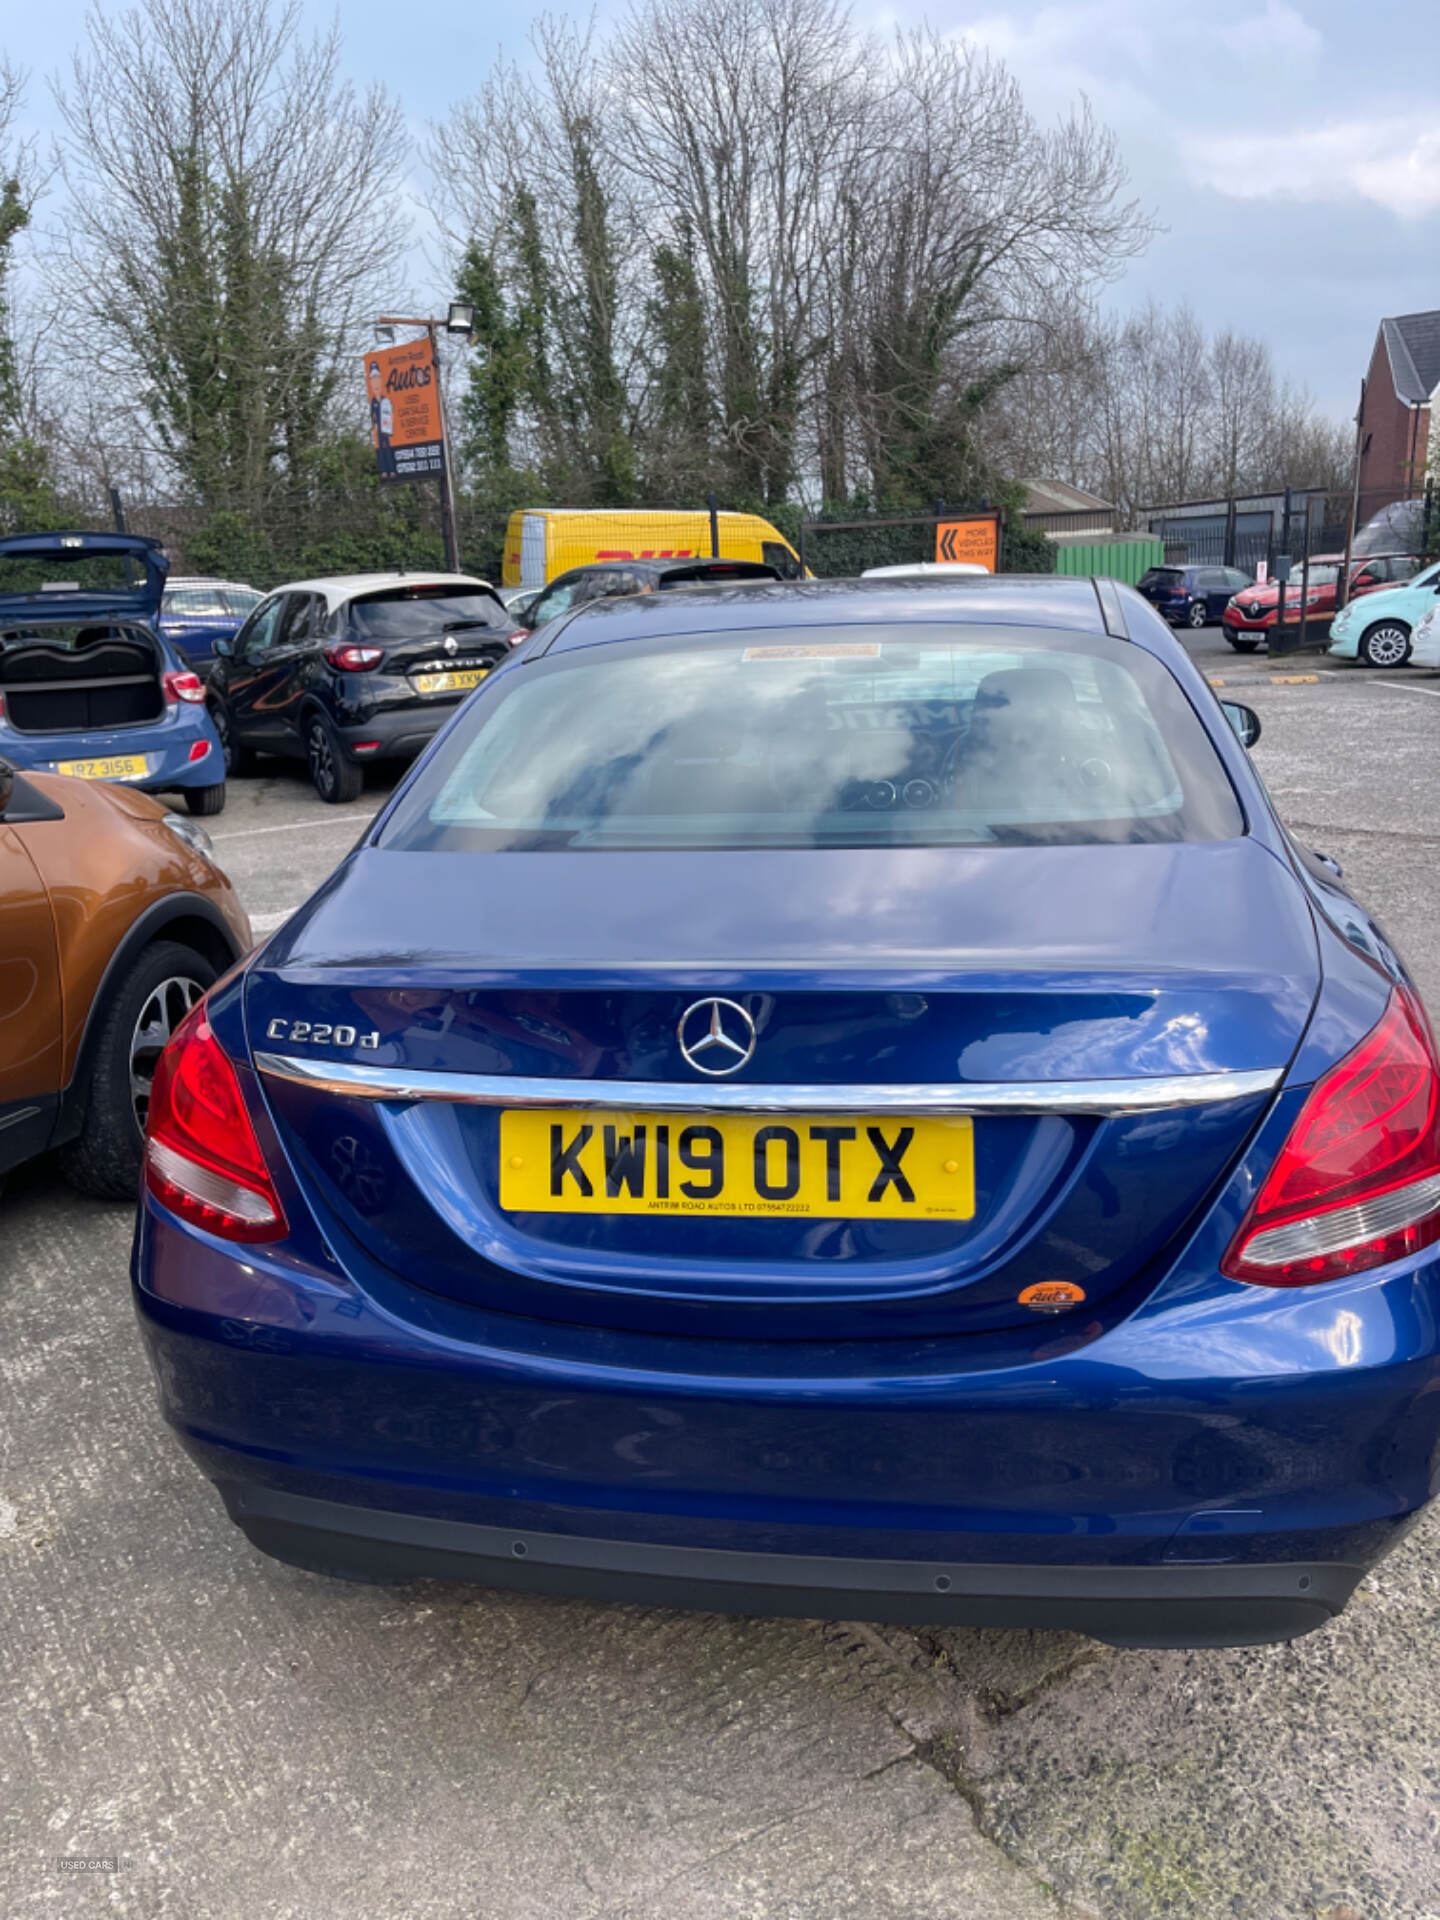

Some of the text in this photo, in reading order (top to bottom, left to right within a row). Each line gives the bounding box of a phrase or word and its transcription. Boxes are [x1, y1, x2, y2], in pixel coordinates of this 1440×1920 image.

[386, 363, 431, 394] Autos
[966, 528, 987, 536] MORE
[959, 537, 994, 547] VEHICLES
[99, 759, 134, 775] 3156
[550, 1124, 916, 1202] KW19 OTX
[648, 1201, 679, 1209] ANTRIM
[682, 1201, 705, 1210] ROAD
[708, 1202, 736, 1211] AUTOS
[738, 1203, 755, 1211] LTD
